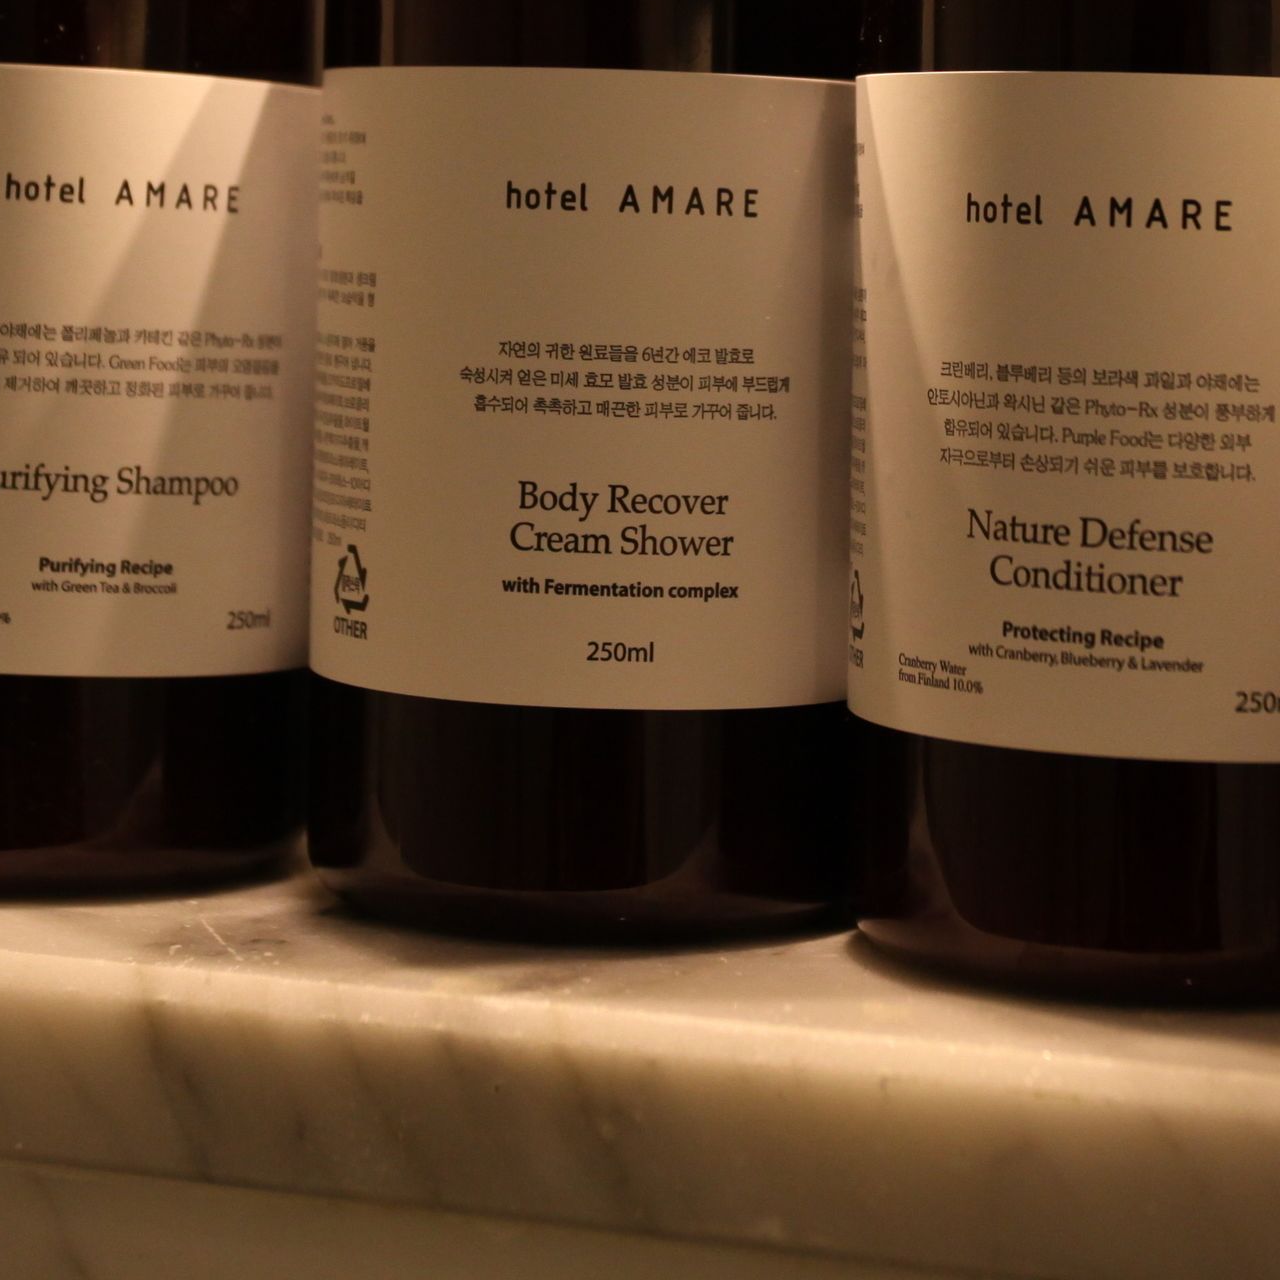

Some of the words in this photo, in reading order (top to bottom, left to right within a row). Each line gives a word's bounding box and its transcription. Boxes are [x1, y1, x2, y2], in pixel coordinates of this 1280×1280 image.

[5, 172, 85, 205] hotel
[115, 179, 240, 213] AMARE
[506, 180, 588, 212] hotel
[619, 183, 759, 218] AMARE
[966, 192, 1043, 225] hotel
[1073, 195, 1232, 232] AMARE
[12, 349, 41, 366] 되어
[45, 350, 106, 369] 있습니다.
[109, 354, 146, 371] Green
[498, 340, 540, 359] 자연의
[544, 342, 575, 361] 귀한
[578, 343, 638, 363] 원료들을
[642, 346, 680, 364] 6년간
[682, 347, 712, 365] 에코
[715, 348, 755, 365] 발효로
[4, 375, 60, 394] 제거하여
[65, 378, 120, 396] 깨끗하고
[459, 365, 513, 385] 숙성시켜
[517, 369, 547, 387] 얻은
[550, 370, 579, 388] 미세
[583, 371, 614, 389] 효모
[618, 373, 648, 391] 발효
[650, 374, 694, 392] 성분이
[697, 375, 738, 393] 피부에
[742, 376, 791, 394] 부드럽게
[997, 363, 1052, 384] 블루베리
[1057, 366, 1087, 386] 등의
[1092, 368, 1138, 388] 보라색
[1144, 371, 1191, 390] 과일과
[1196, 373, 1261, 393] 야채에는
[473, 393, 529, 414] 흡수되어
[532, 396, 592, 416] 촉촉하고
[596, 400, 641, 418] 매끈한
[644, 401, 689, 419] 피부로
[691, 402, 732, 420] 가꾸어
[735, 403, 778, 421] 줍니다.
[927, 388, 1000, 411] 안토시아닌과
[1051, 396, 1081, 415] 같은
[1163, 402, 1209, 421] 성분이
[1215, 403, 1276, 423] 풍부하게
[944, 418, 993, 439] 함유되어
[997, 422, 1058, 444] 있습니다.
[1062, 426, 1106, 447] Purple
[1110, 429, 1164, 450] Food는
[1168, 431, 1216, 452] 다양한
[1221, 433, 1252, 452] 외부
[940, 447, 1015, 470] 자극으로부터
[1020, 453, 1079, 475] 손상되기
[1084, 456, 1115, 478] 쉬운
[1120, 459, 1168, 480] 피부를
[1171, 461, 1256, 482] 보호합니다.
[116, 465, 239, 505] Shampoo
[518, 480, 600, 522] Body
[607, 484, 729, 516] Recover
[510, 521, 613, 555] Cream
[619, 524, 735, 557] Shower
[967, 508, 1071, 546] Nature
[1079, 516, 1214, 554] Defense
[39, 556, 116, 577] Purifying
[121, 559, 174, 578] Recipe
[989, 554, 1184, 598] Conditioner
[31, 579, 58, 592] with
[61, 580, 97, 593] Green
[100, 582, 119, 594] Tea
[122, 582, 131, 594] &
[134, 582, 177, 595] Broccoli
[502, 577, 540, 594] with
[544, 578, 664, 599] Fermentation
[667, 582, 739, 603] complex
[226, 608, 271, 630] 250ml
[334, 616, 368, 640] OTHER
[1002, 620, 1096, 648] Protecting
[1100, 628, 1165, 652] Recipe
[586, 641, 655, 663] 250ml
[898, 652, 937, 674] Cranberry
[939, 659, 968, 676] Water
[968, 643, 993, 658] with
[995, 645, 1058, 667] Cranberry,
[1061, 650, 1124, 671] Blueberry
[1128, 657, 1138, 671] &
[1141, 657, 1205, 673] Lavender
[898, 668, 916, 684] from
[918, 671, 950, 689] Finland
[953, 677, 984, 694] 10.0%
